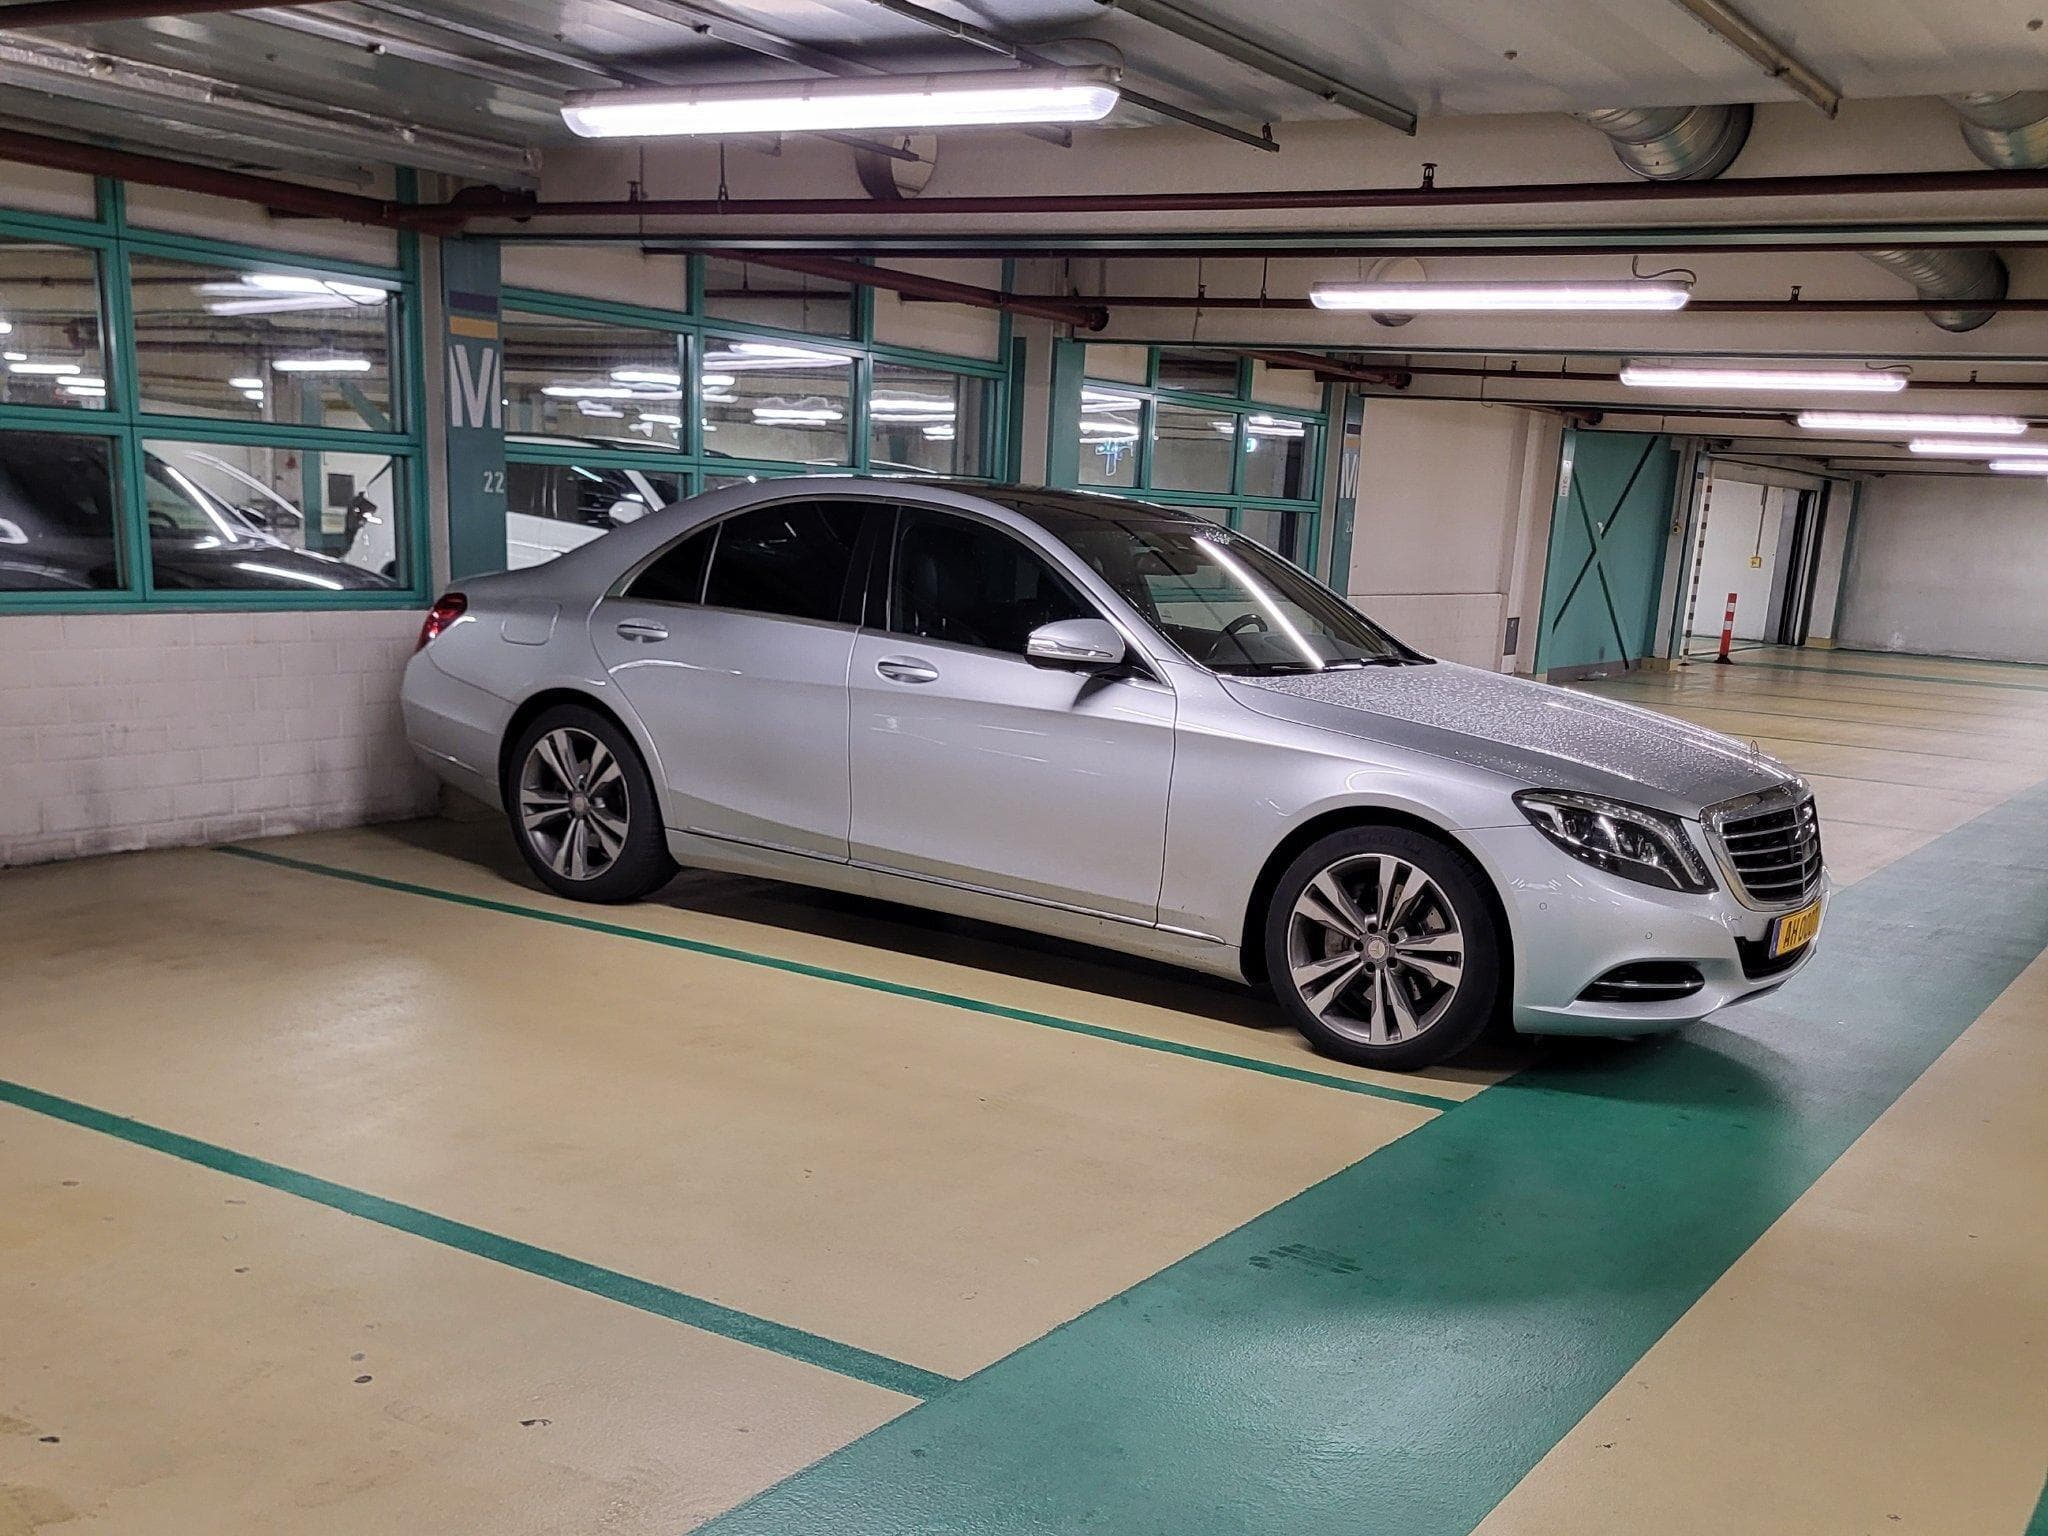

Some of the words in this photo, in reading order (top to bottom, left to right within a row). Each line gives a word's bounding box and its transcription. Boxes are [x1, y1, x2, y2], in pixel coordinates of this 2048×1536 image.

[448, 344, 502, 429] M
[483, 471, 505, 493] 22
[1339, 453, 1360, 499] M
